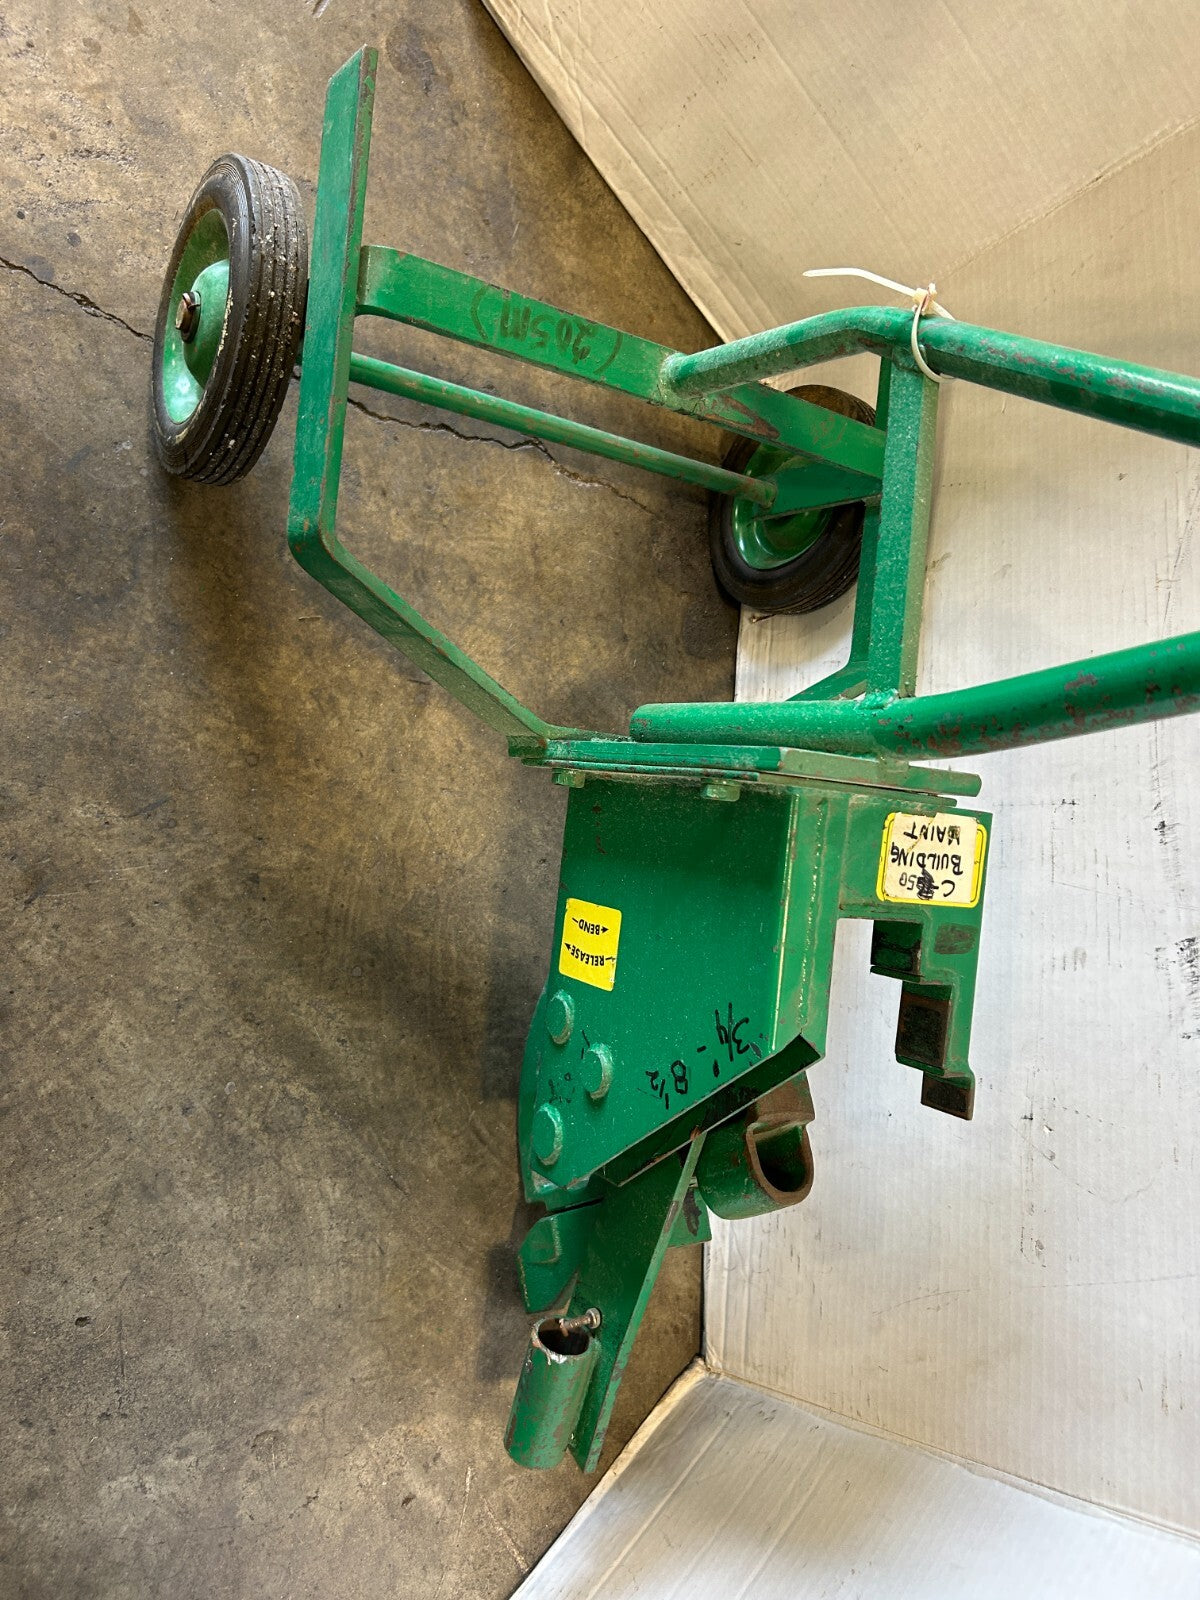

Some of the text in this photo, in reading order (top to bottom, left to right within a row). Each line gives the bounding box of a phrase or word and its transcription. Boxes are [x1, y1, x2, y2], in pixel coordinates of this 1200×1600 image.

[890, 841, 964, 876] BUILDING
[578, 918, 601, 936] BEND
[570, 944, 605, 967] RELEASE
